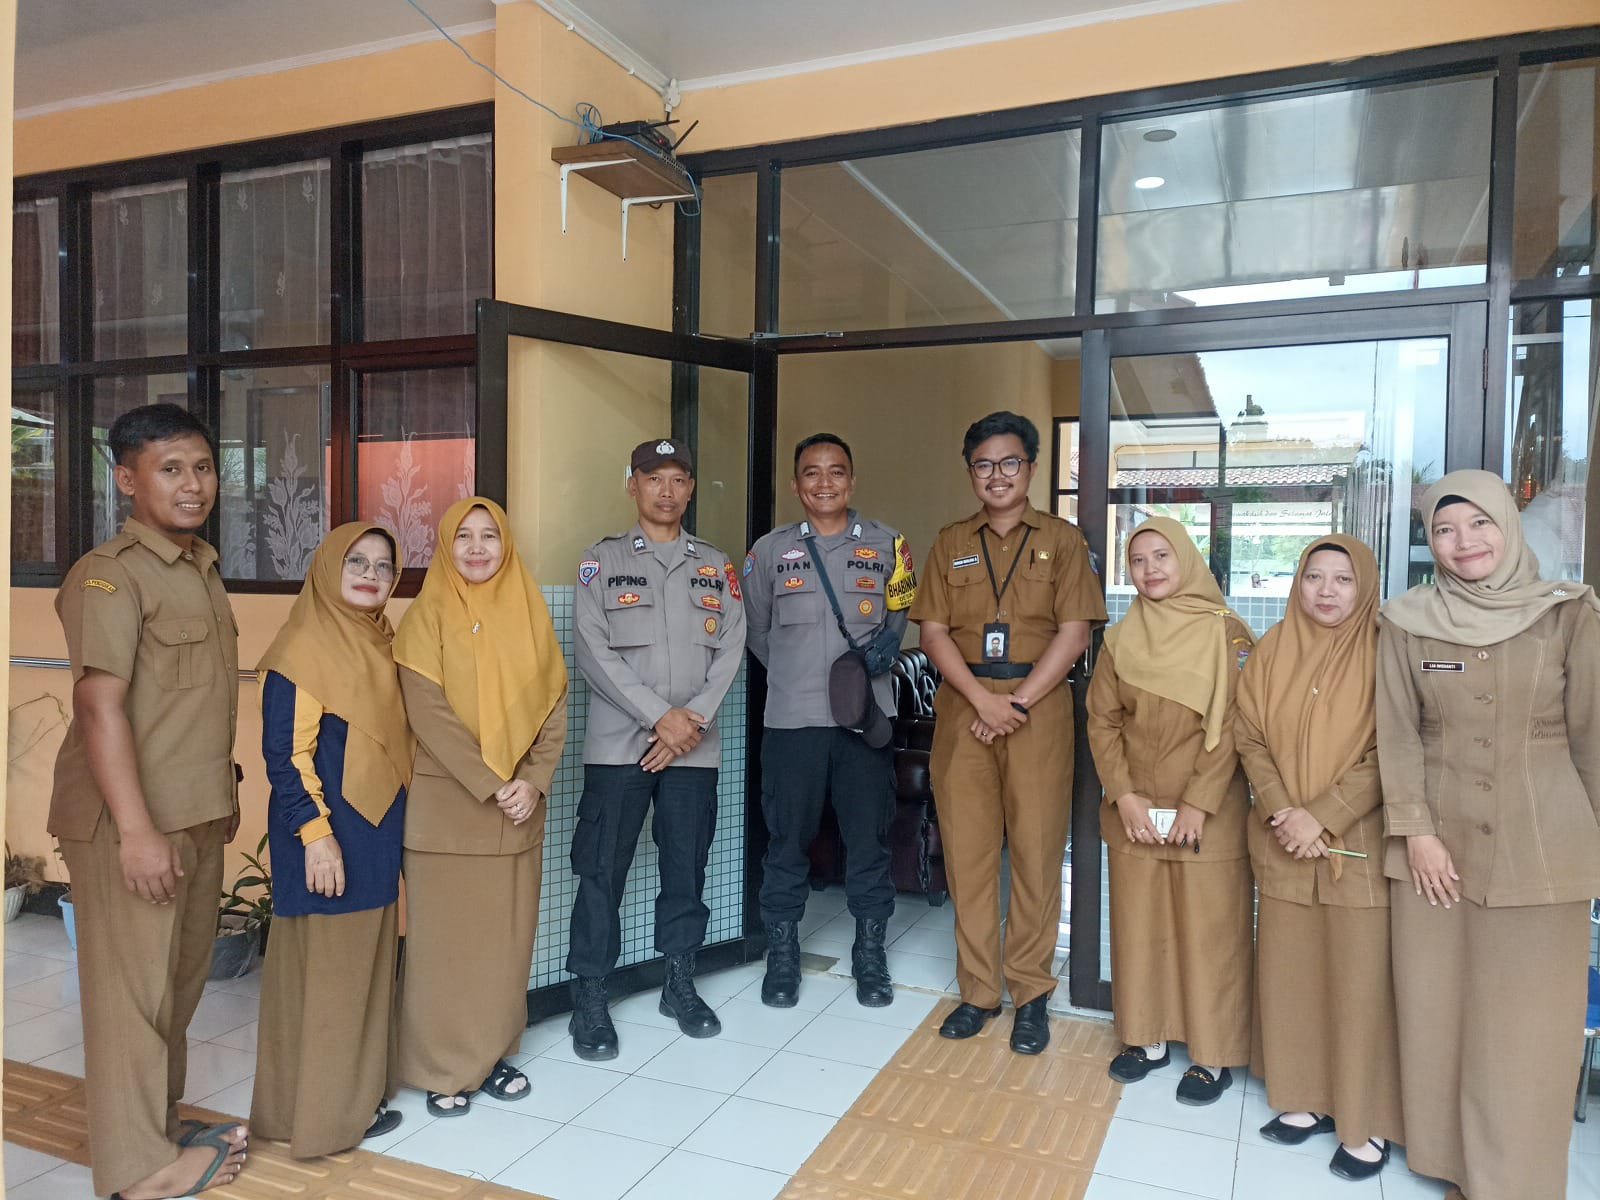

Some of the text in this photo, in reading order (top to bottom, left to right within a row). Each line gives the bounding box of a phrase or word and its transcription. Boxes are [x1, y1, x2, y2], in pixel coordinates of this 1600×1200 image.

[777, 561, 811, 574] DIAN
[847, 560, 884, 573] POLRI
[608, 575, 648, 588] PIPING
